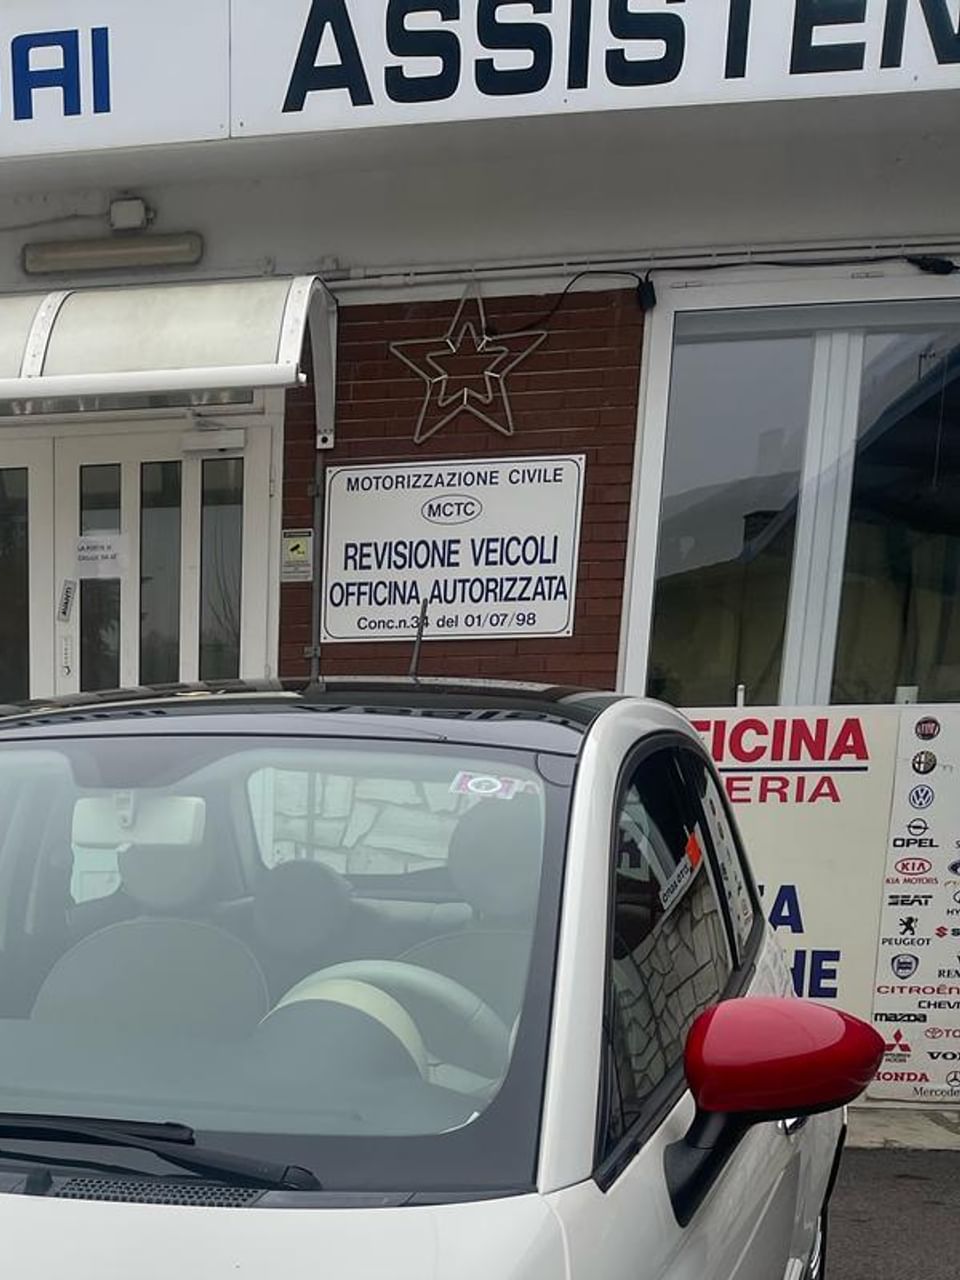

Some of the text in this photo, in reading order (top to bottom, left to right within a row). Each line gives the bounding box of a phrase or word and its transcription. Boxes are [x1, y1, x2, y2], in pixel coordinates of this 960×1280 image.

[346, 468, 563, 491] MOTORIZZAZIONE CIVILE
[427, 502, 475, 517] MCTC
[344, 539, 461, 570] REVISIONE
[471, 536, 558, 566] VEICOLI
[330, 576, 568, 607] OFFICINA AUTORIZZATA
[436, 614, 458, 628] del
[464, 612, 537, 628] 01/07/98
[690, 718, 869, 763] ICINA
[893, 838, 939, 848] OPEL
[901, 862, 926, 872] KIA
[888, 895, 933, 906] SEAT
[881, 938, 931, 946] PEUGEOT
[927, 1051, 960, 1061] VO
